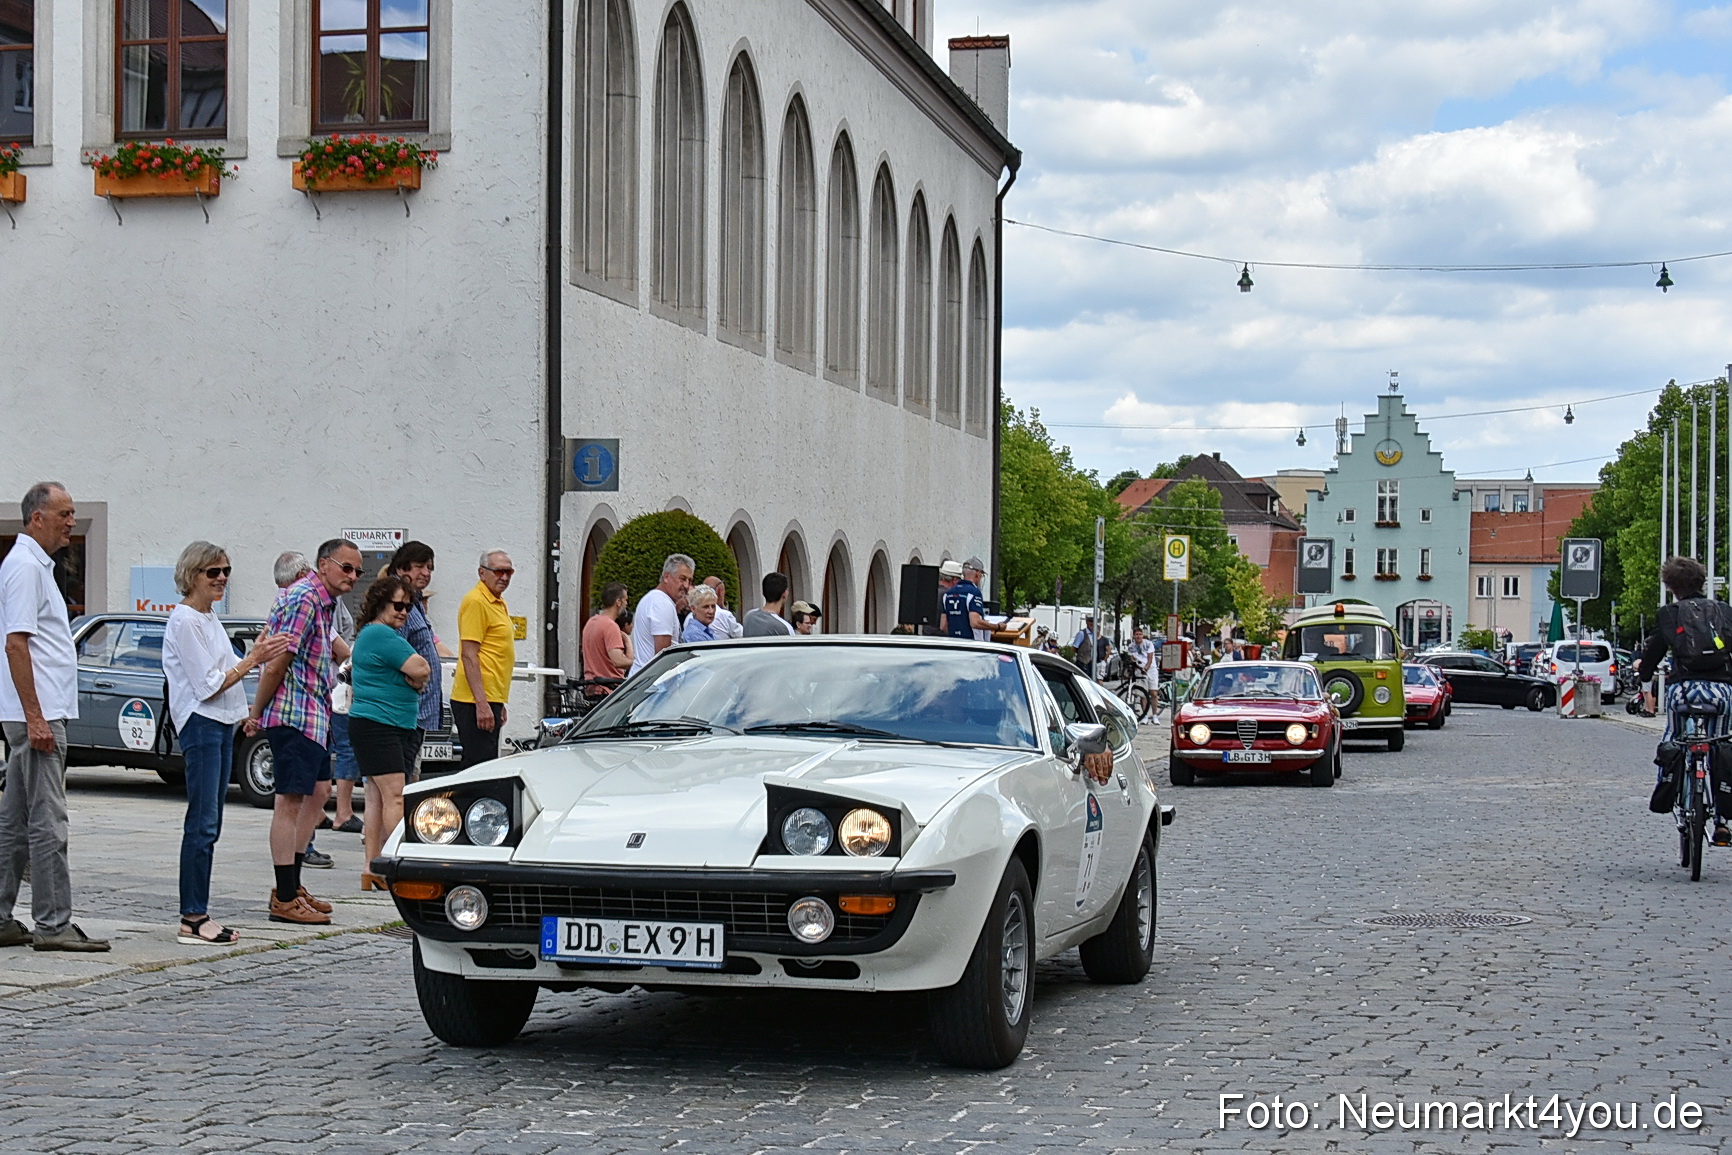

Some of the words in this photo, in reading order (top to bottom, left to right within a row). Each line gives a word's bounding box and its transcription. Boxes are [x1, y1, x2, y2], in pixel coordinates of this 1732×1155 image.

[344, 531, 392, 540] NEUMARKT
[1172, 543, 1181, 555] H
[131, 726, 143, 740] 82
[422, 745, 433, 758] TZ
[1228, 752, 1240, 761] LB
[545, 938, 553, 949] D
[565, 921, 602, 951] DD
